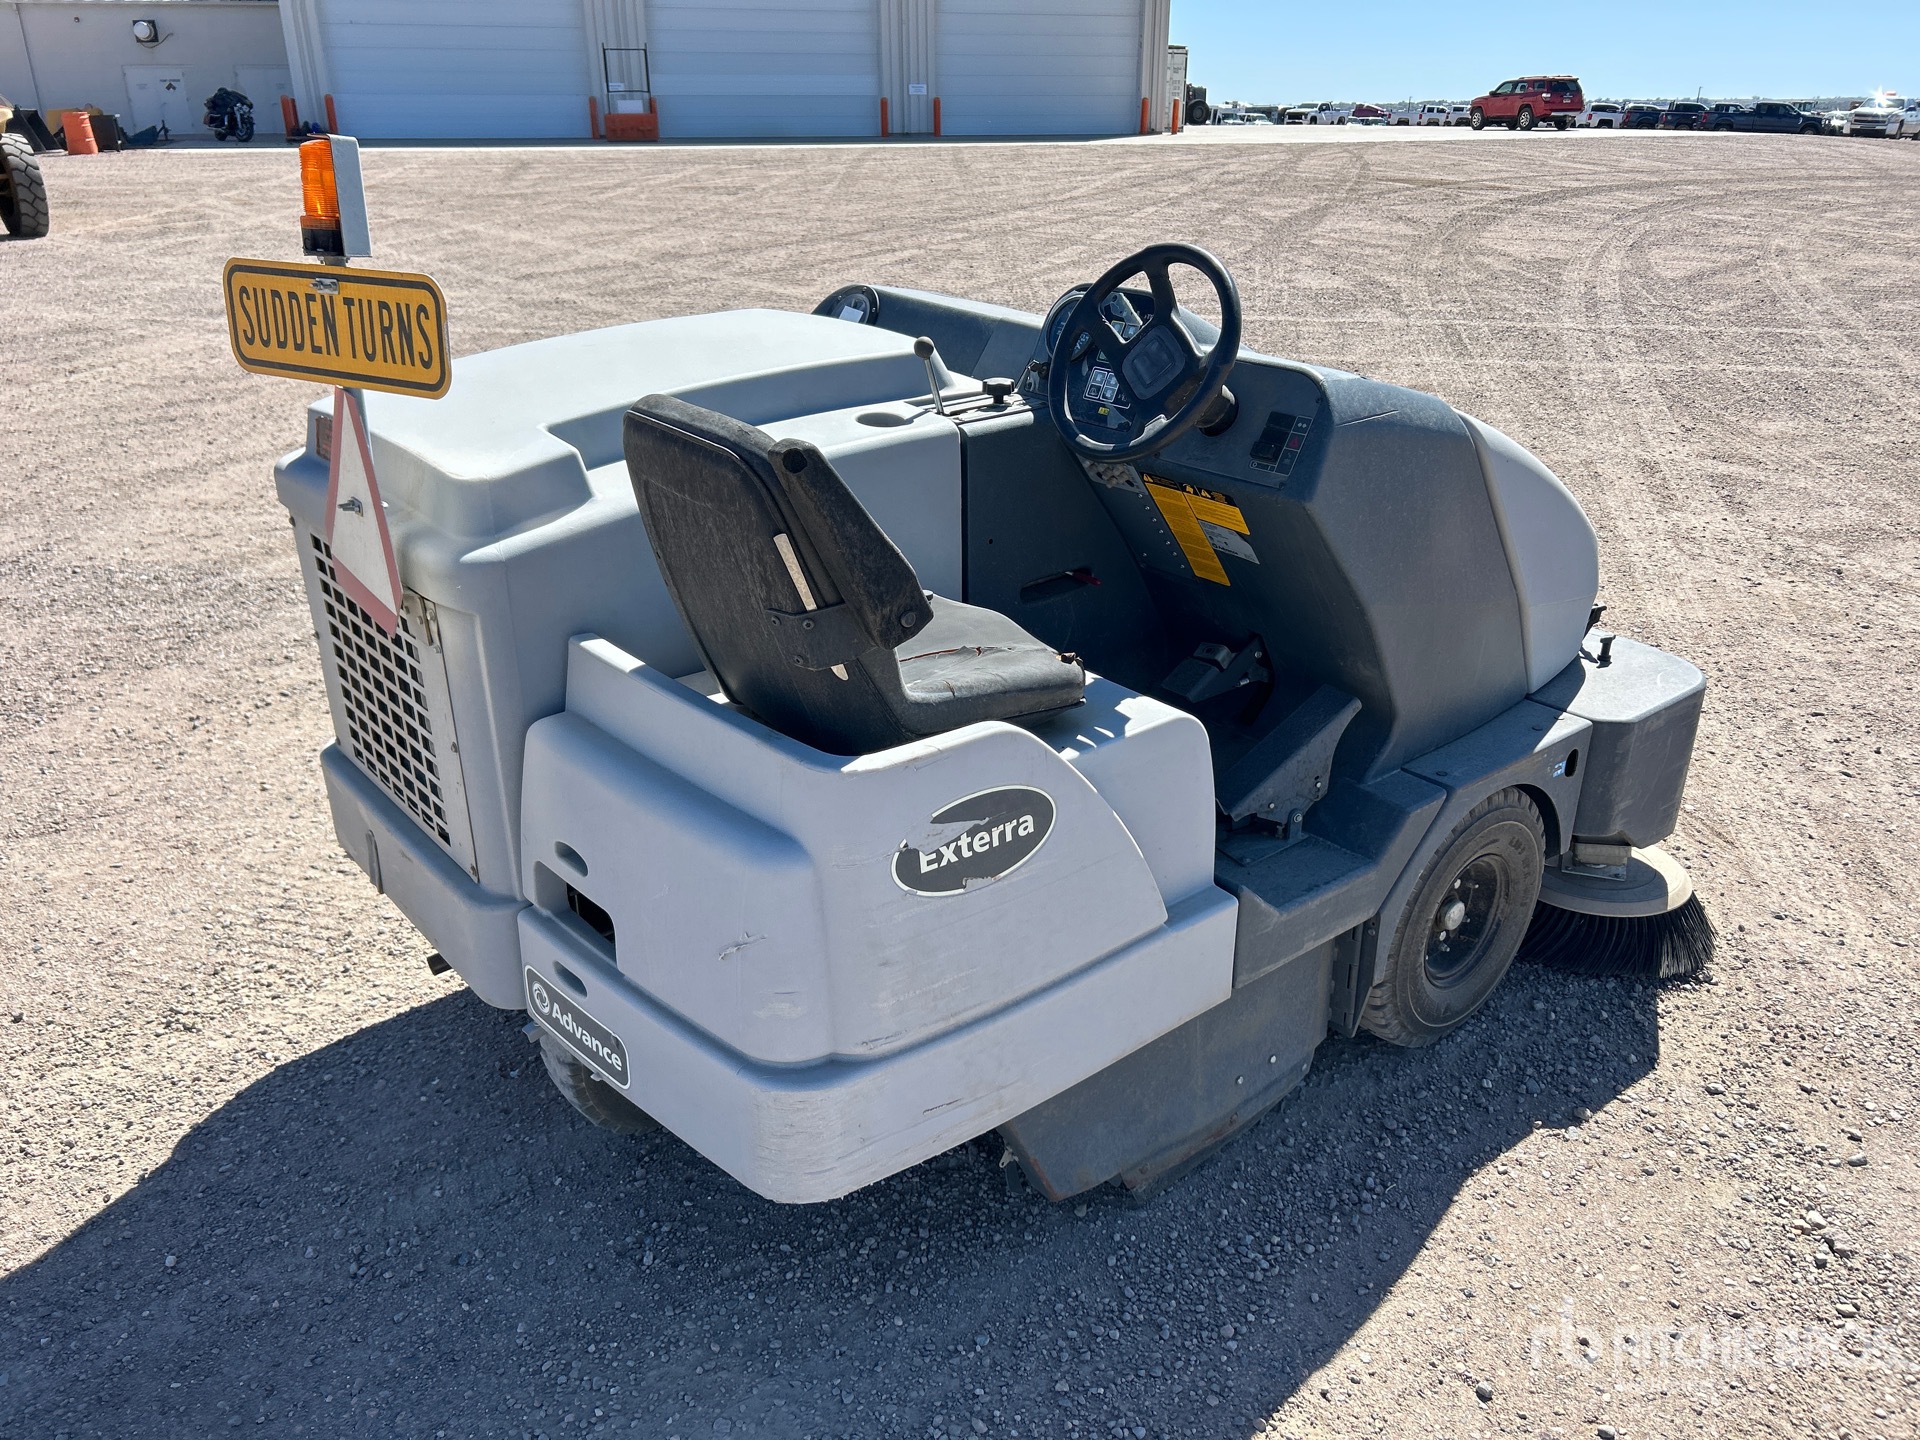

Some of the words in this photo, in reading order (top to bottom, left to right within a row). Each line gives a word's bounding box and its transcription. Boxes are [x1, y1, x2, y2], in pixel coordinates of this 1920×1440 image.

[239, 285, 340, 357] SUDDEN
[342, 296, 433, 370] TURNS
[919, 814, 1036, 874] Exterra
[552, 1002, 623, 1072] Advance
